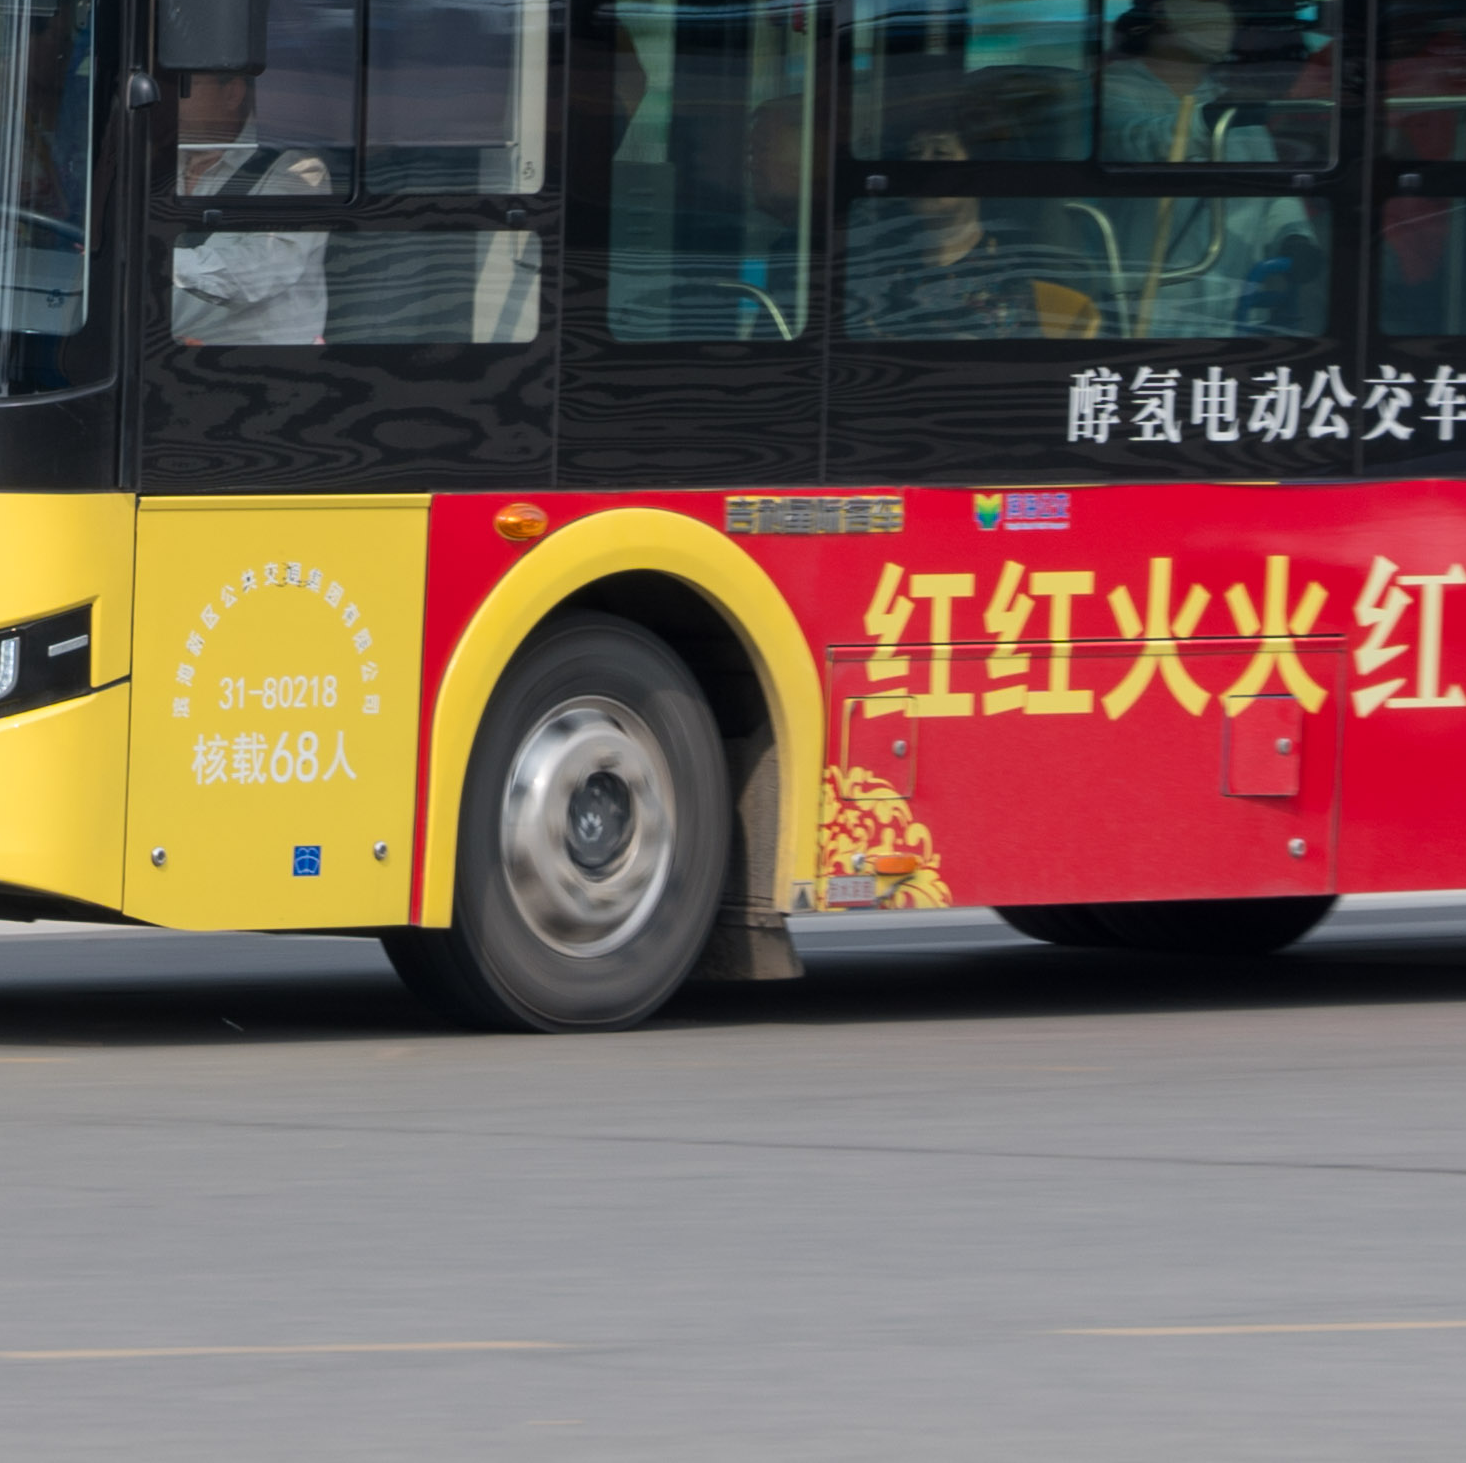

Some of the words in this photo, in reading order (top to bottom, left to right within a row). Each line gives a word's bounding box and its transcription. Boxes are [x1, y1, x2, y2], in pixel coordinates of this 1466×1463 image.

[862, 555, 1330, 720] 红红火火
[218, 674, 339, 710] 31-80218
[191, 730, 358, 786] 核载68人
